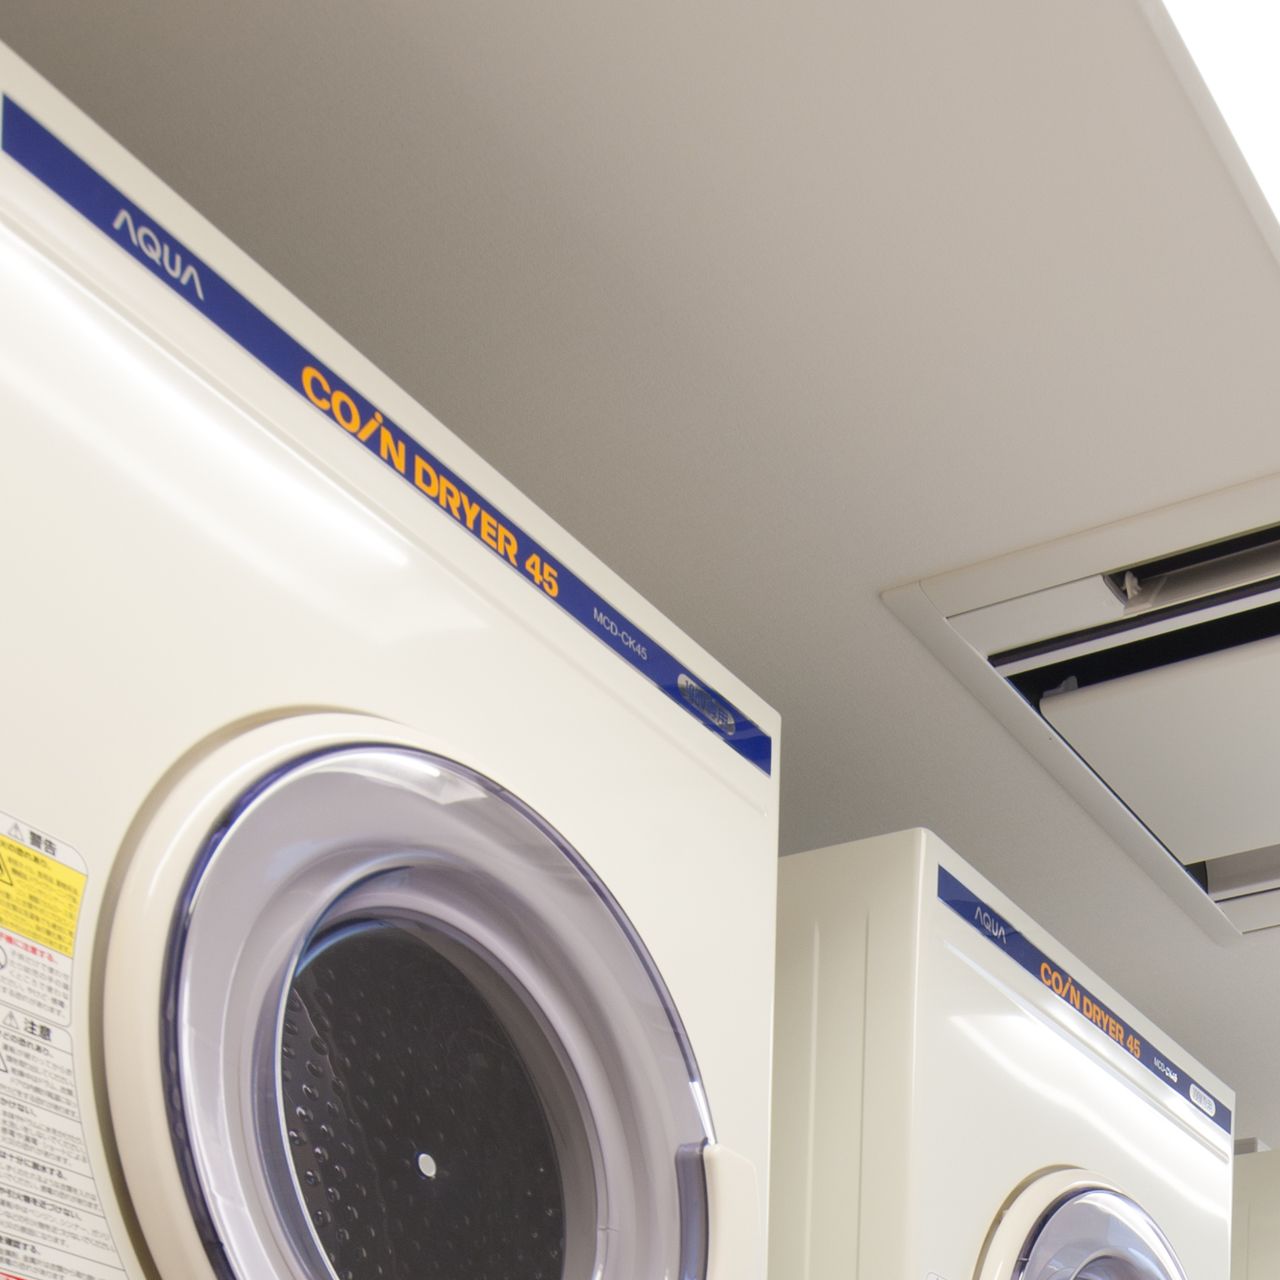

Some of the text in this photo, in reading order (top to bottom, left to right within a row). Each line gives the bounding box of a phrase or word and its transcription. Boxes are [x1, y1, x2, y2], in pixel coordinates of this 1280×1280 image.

[112, 208, 204, 301] AQUA
[414, 454, 518, 567] DRYER
[525, 553, 559, 599] 45
[593, 606, 648, 661] MCD-CK45
[29, 830, 57, 857] 警告
[975, 906, 1006, 944] AQUA
[1083, 996, 1124, 1046] DRYER
[1127, 1037, 1141, 1059] 45
[24, 1017, 52, 1042] 注意
